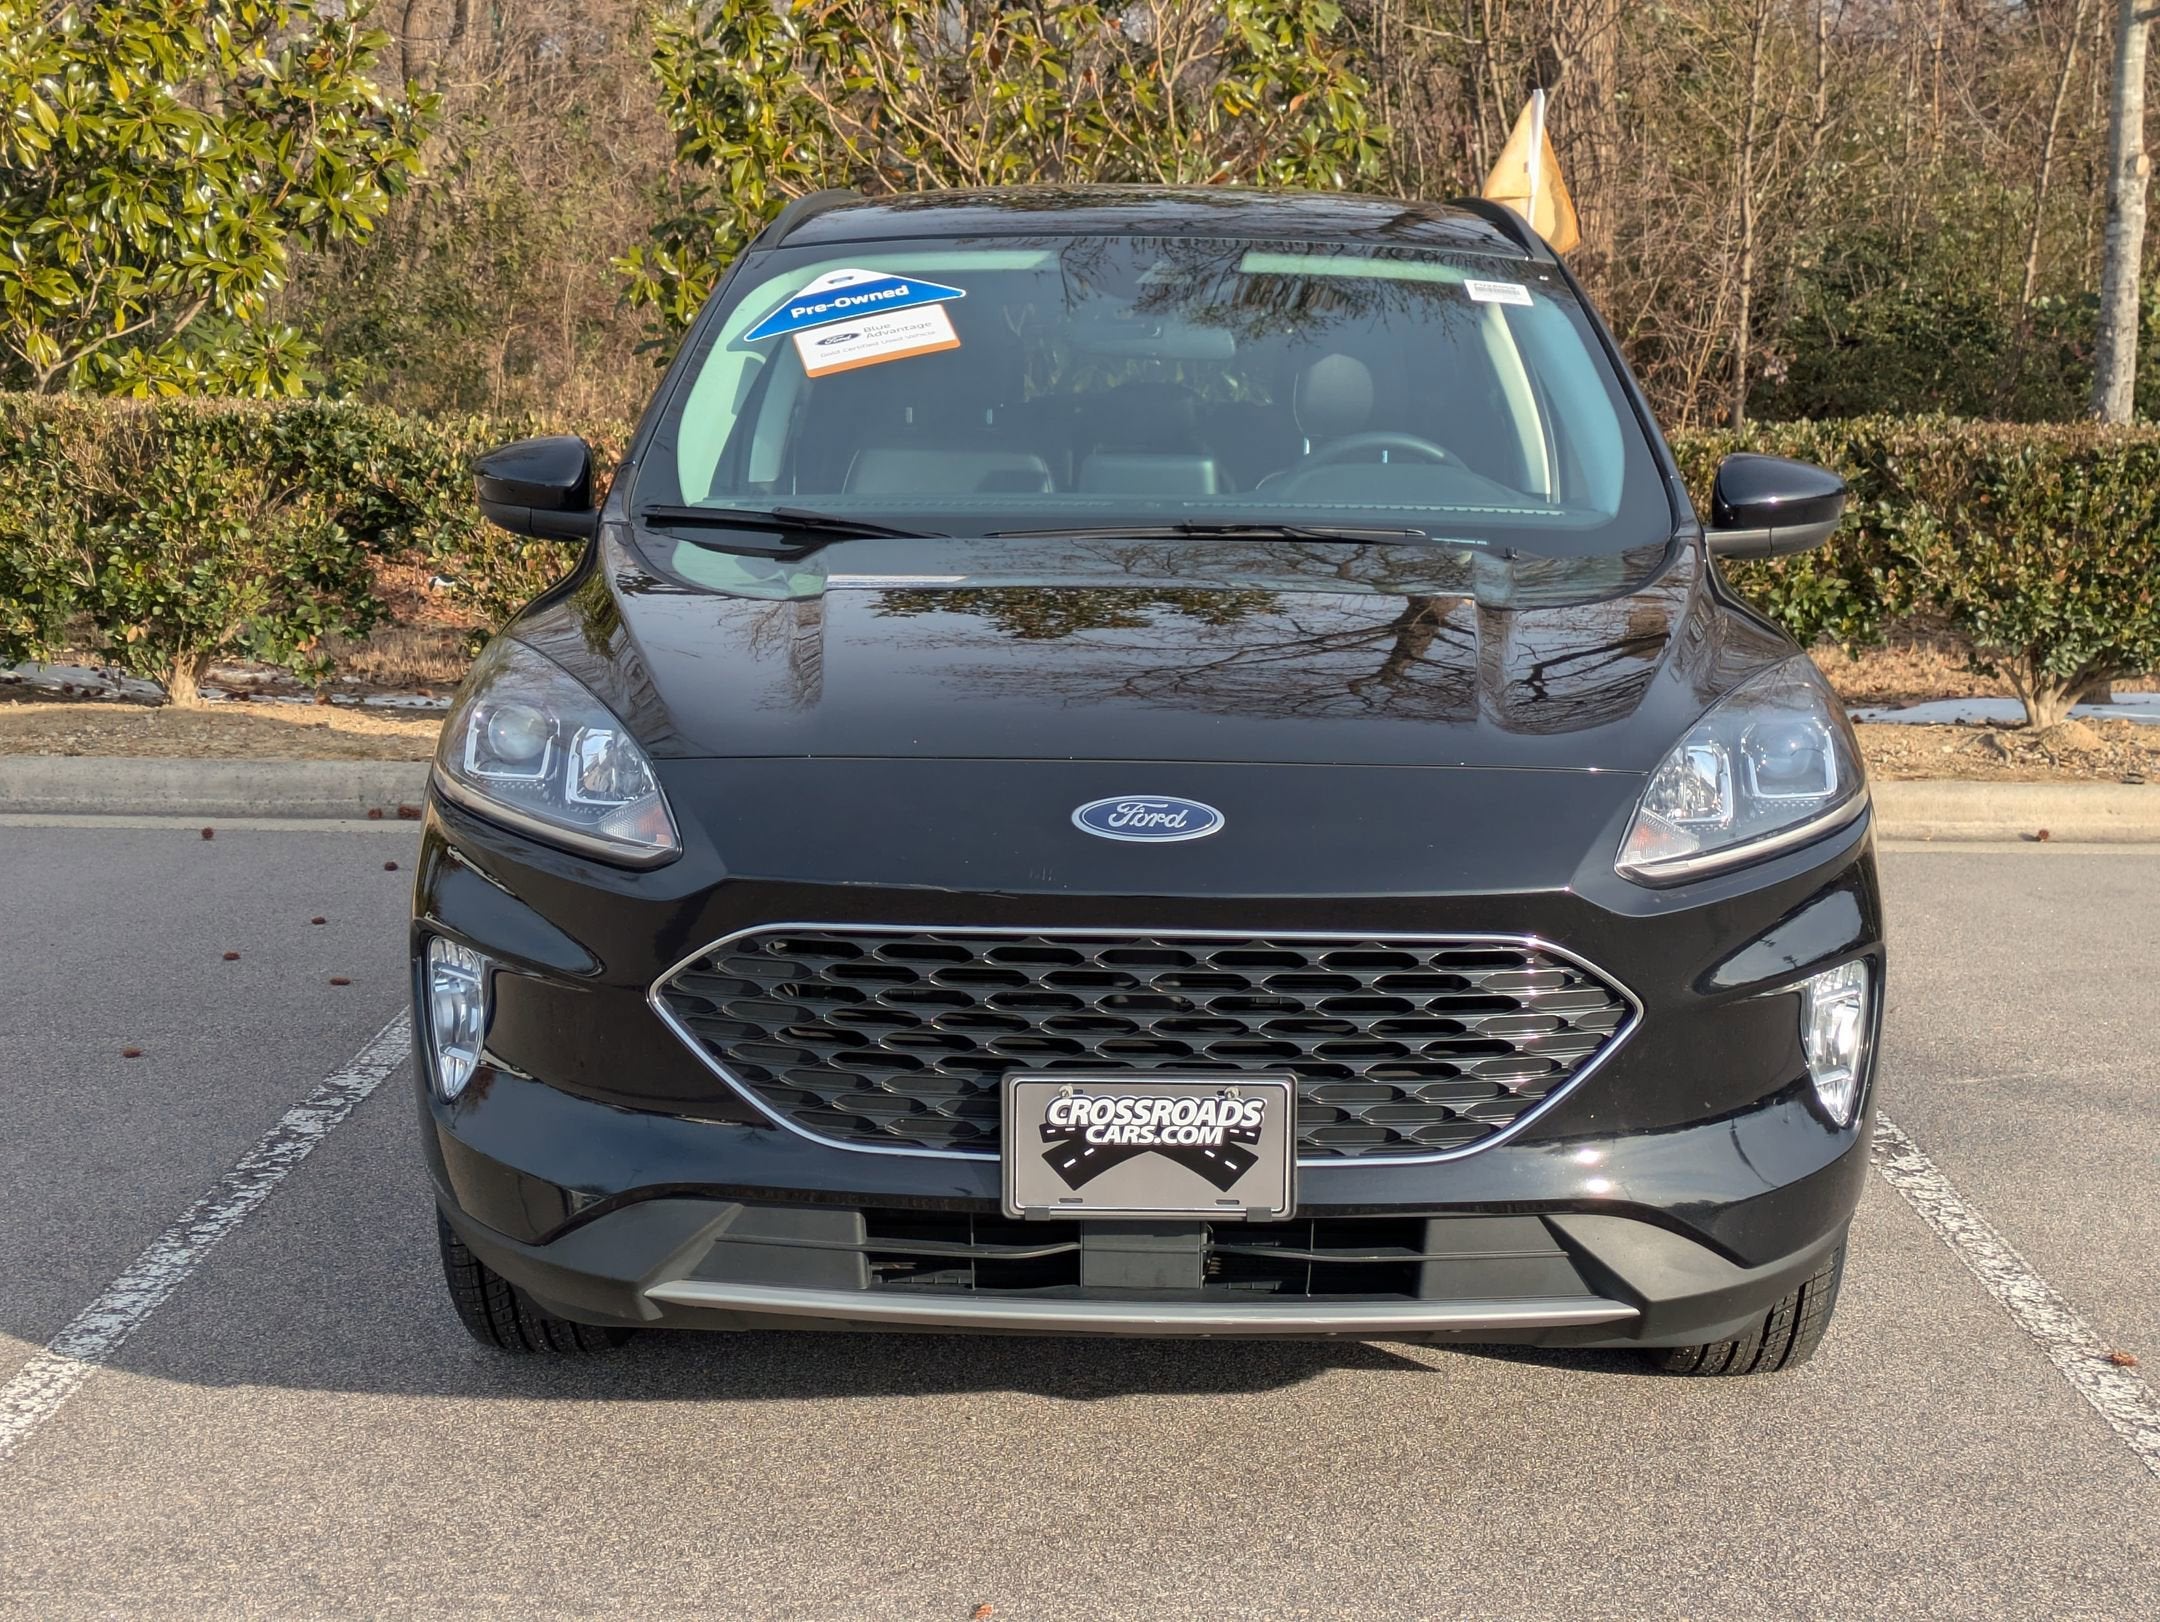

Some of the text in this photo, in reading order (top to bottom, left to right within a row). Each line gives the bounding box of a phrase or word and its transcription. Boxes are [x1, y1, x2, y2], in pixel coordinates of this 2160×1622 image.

[791, 285, 909, 318] Pre-Owned
[864, 323, 891, 333] Blue
[867, 321, 932, 339] Advantage
[1108, 802, 1188, 828] Ford
[1047, 1097, 1265, 1128] CROSSROADS
[1085, 1125, 1225, 1145] CARS.COM
